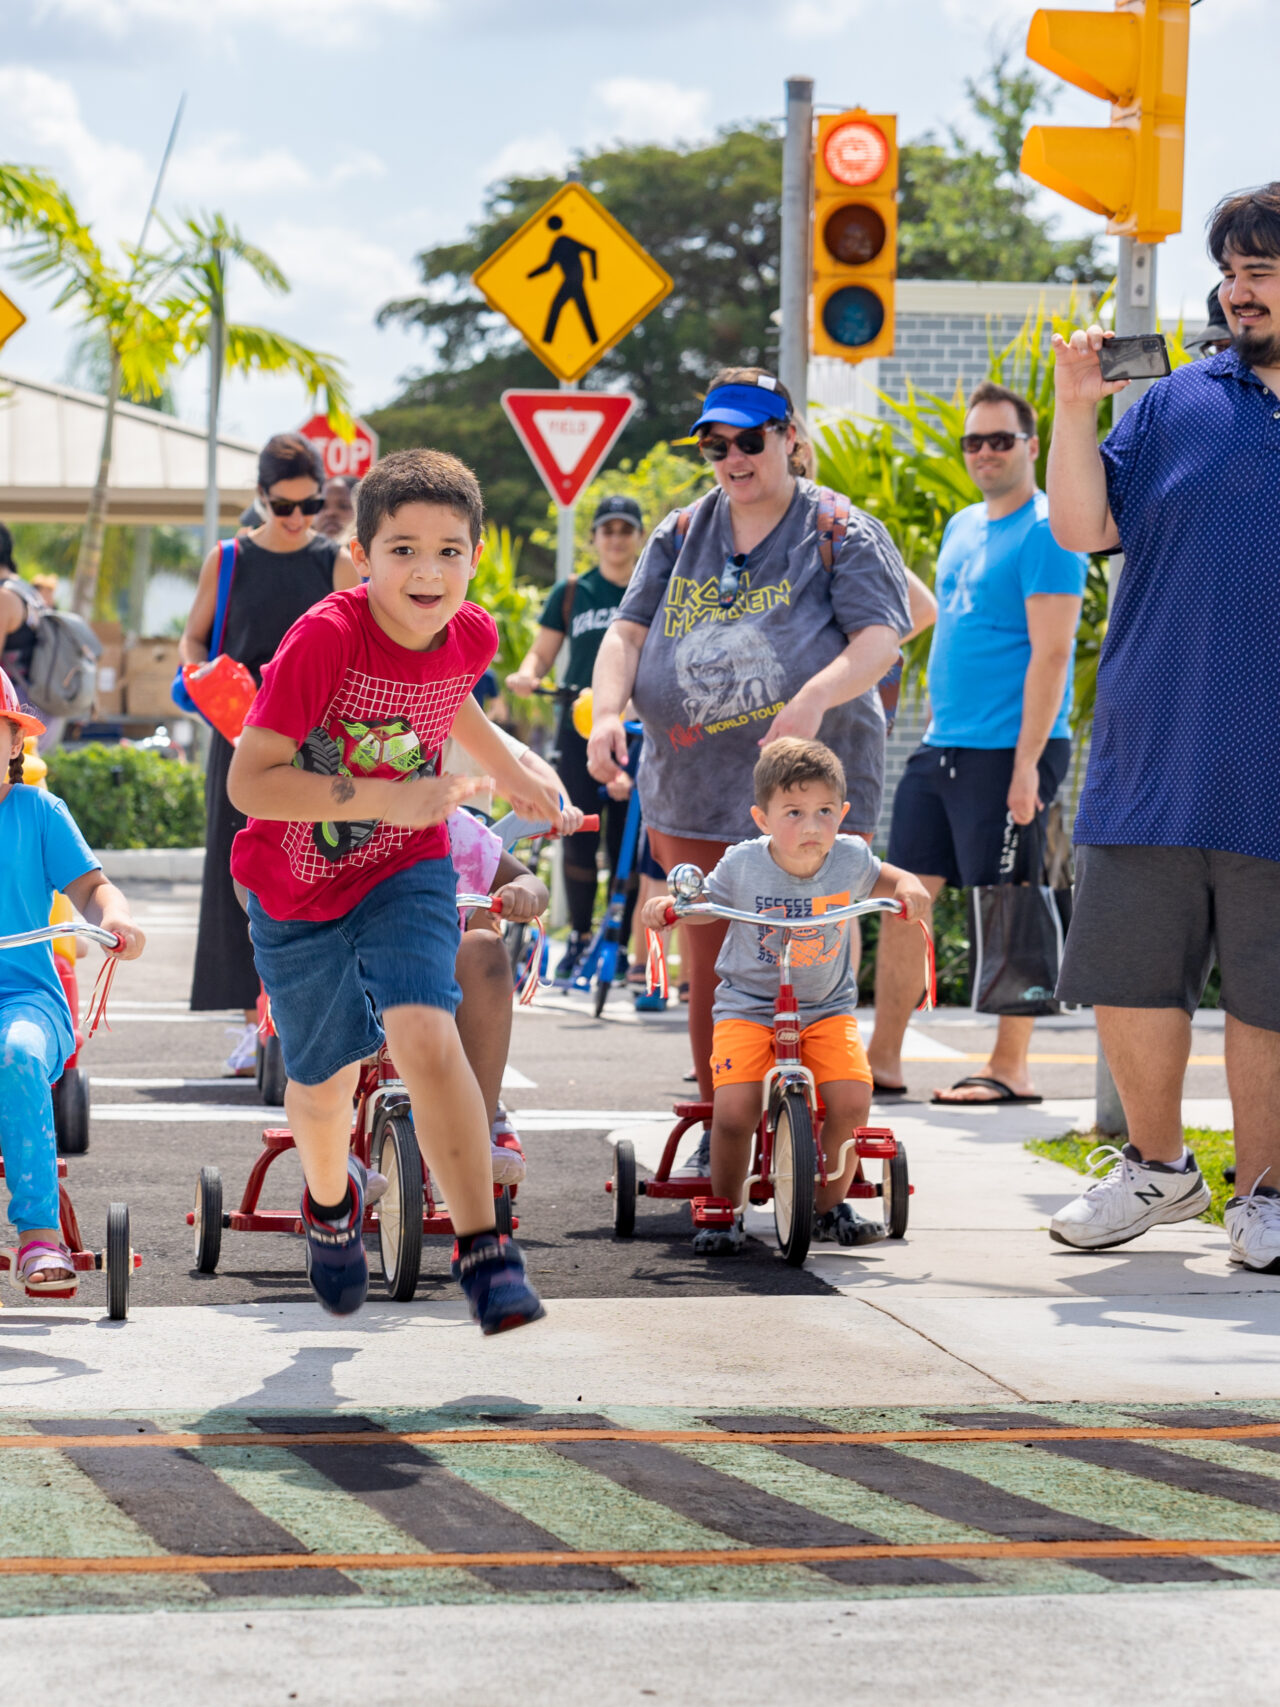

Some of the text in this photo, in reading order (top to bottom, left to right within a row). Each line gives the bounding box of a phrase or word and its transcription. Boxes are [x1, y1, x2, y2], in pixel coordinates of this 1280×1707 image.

[547, 419, 588, 435] YIELD
[312, 437, 370, 474] TOP
[704, 715, 749, 735] WORLD
[749, 701, 786, 723] TOUR
